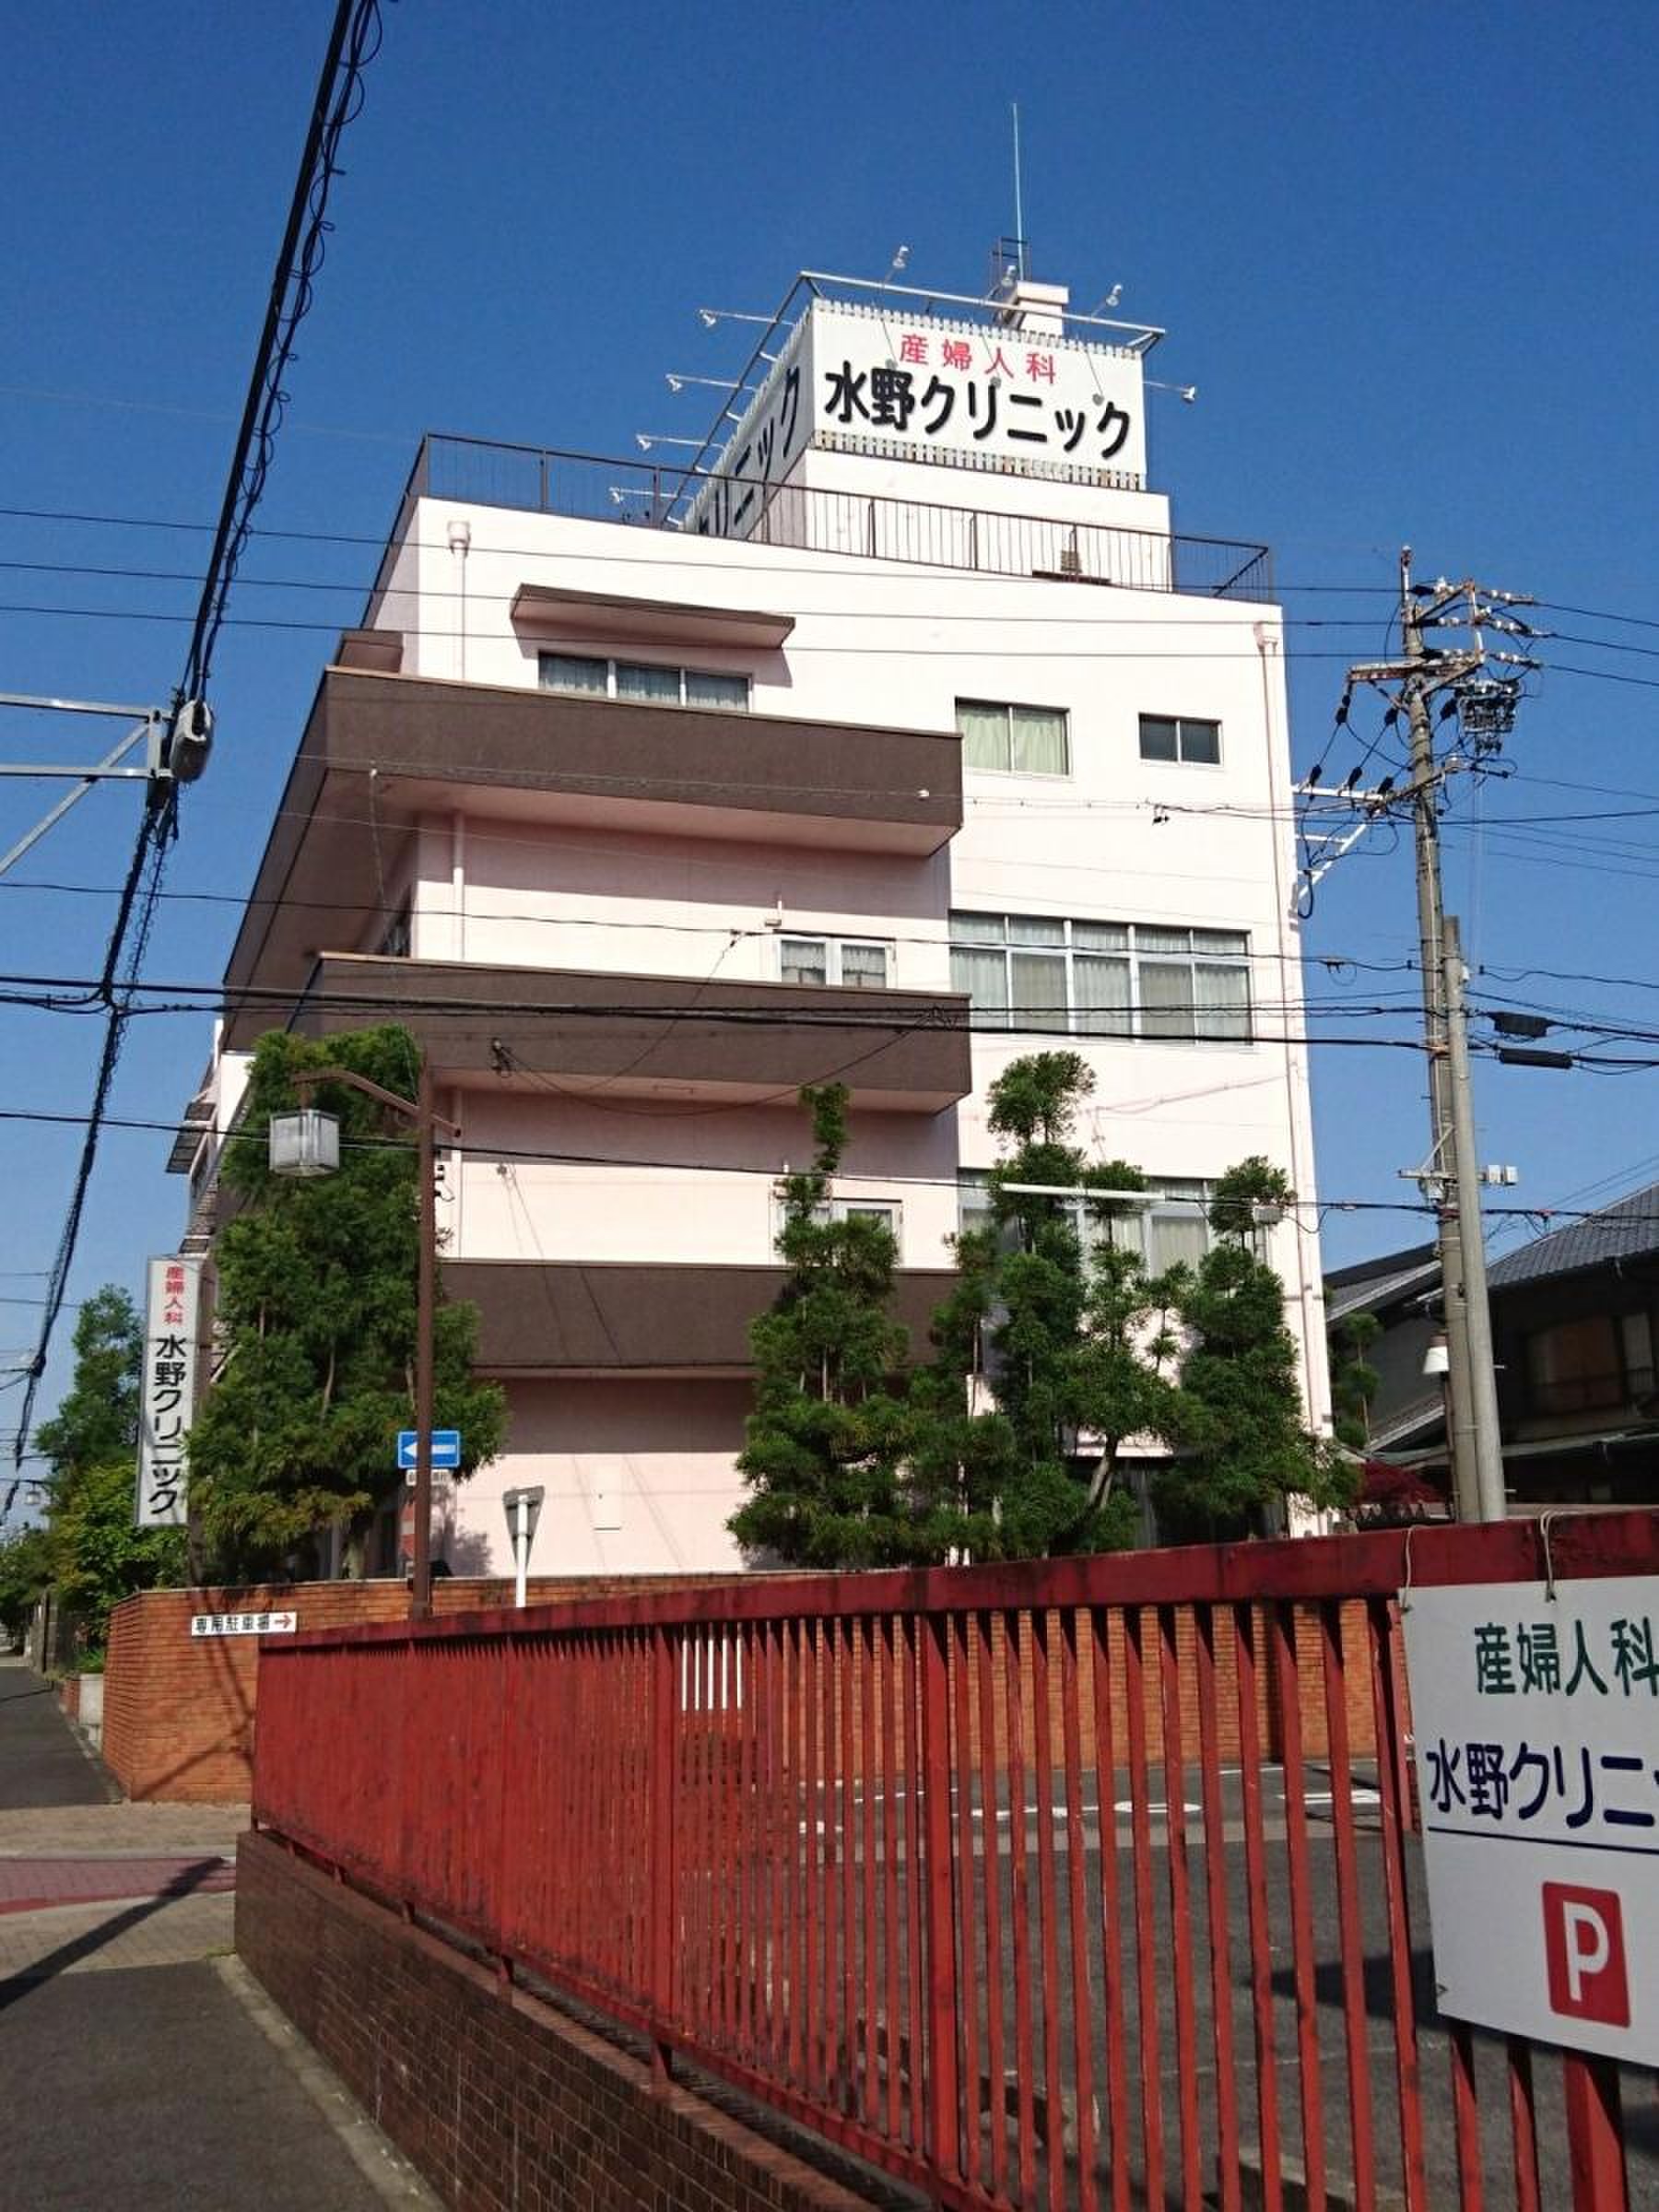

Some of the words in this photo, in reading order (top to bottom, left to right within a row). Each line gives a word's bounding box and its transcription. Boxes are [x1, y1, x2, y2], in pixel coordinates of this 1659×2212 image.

[899, 333, 1057, 385] 産婦人科
[825, 360, 1131, 459] 水野クリニック
[164, 1265, 185, 1326] 産婦人科
[148, 1333, 187, 1514] 水野クリニック
[1475, 1617, 1659, 1697] 産婦人科
[1427, 1738, 1659, 1829] 水野クリニ
[1563, 1900, 1609, 2002] P
